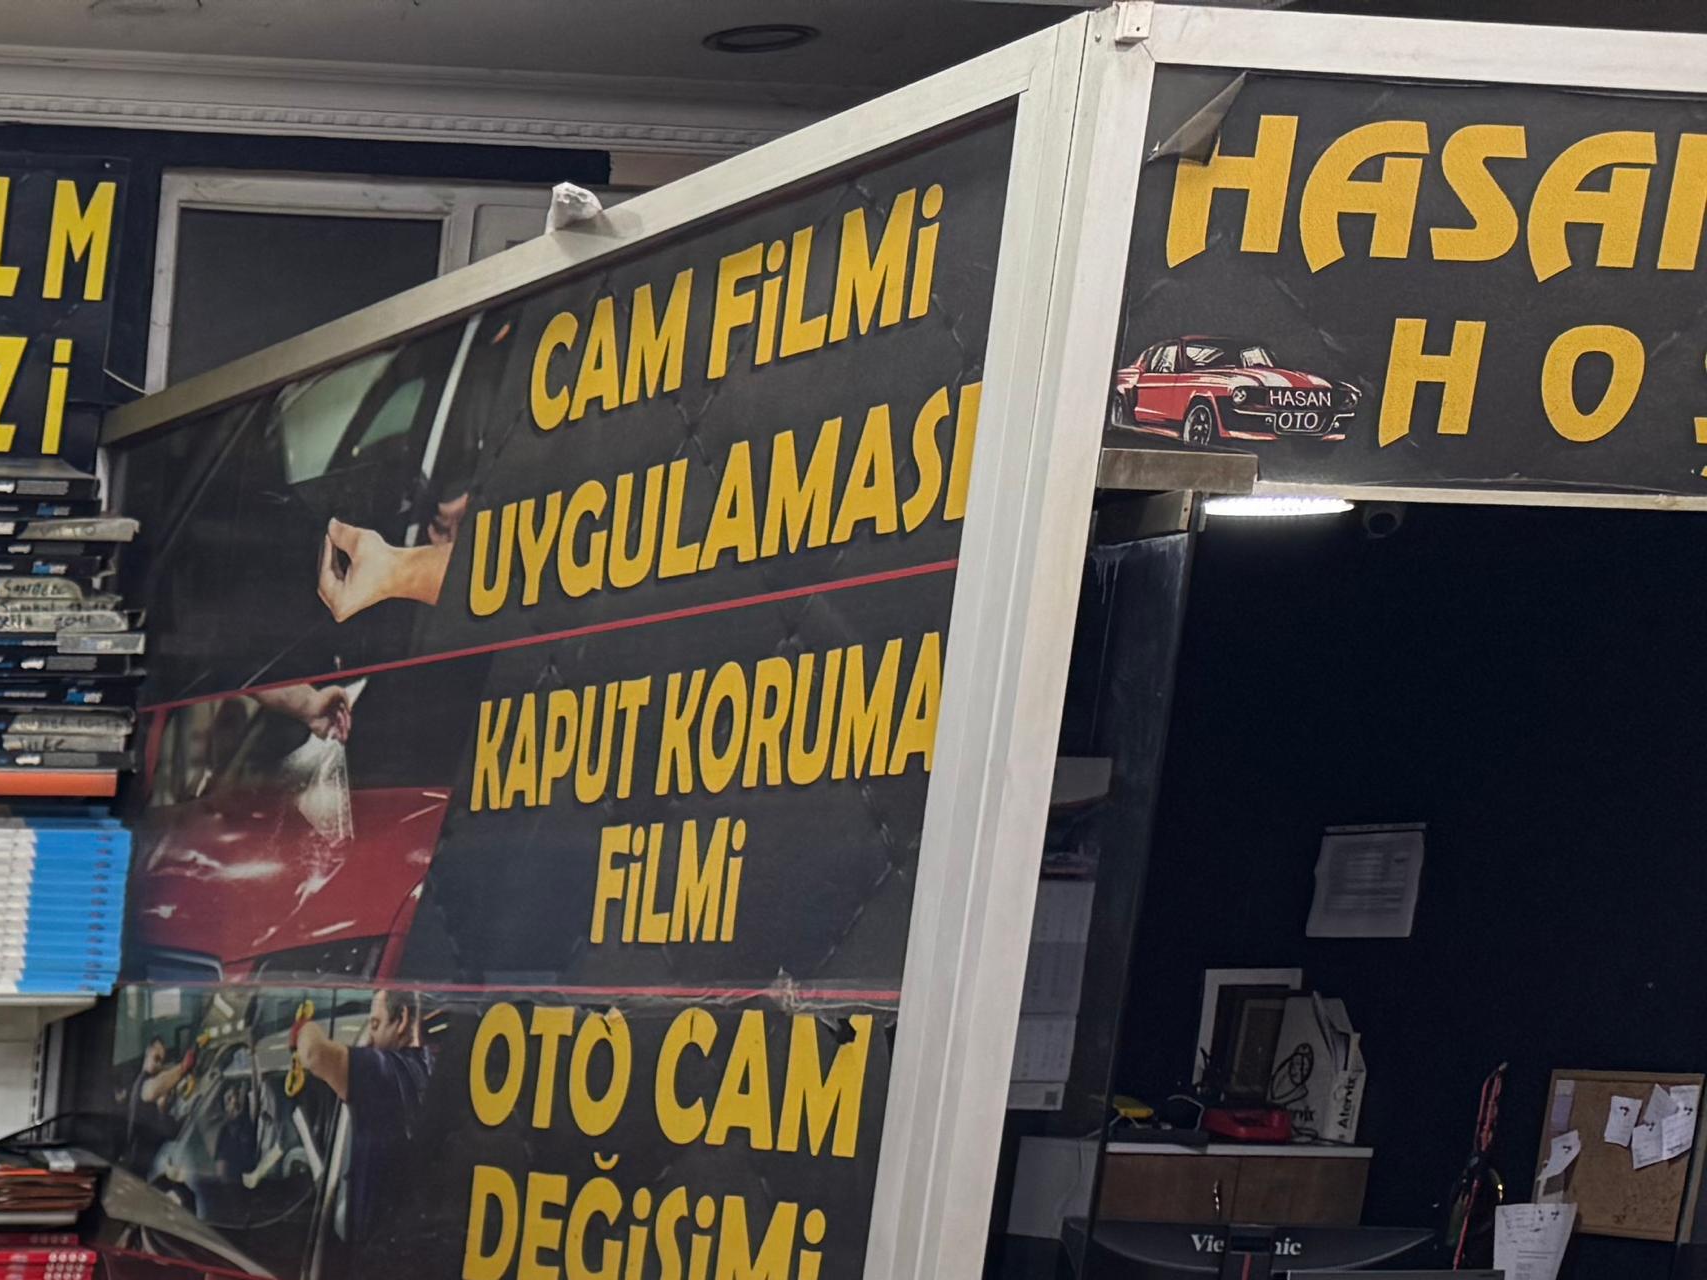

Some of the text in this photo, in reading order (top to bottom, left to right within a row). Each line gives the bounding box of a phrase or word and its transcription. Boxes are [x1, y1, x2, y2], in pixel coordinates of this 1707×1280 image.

[531, 268, 695, 431] CAM
[1268, 388, 1333, 408] HASAN
[1277, 412, 1319, 432] OTO
[1378, 318, 1707, 447] HO
[469, 381, 983, 617] UYGULAMASI
[471, 631, 943, 812] KAPUT KORUMA
[469, 1002, 874, 1158] OTO CAM
